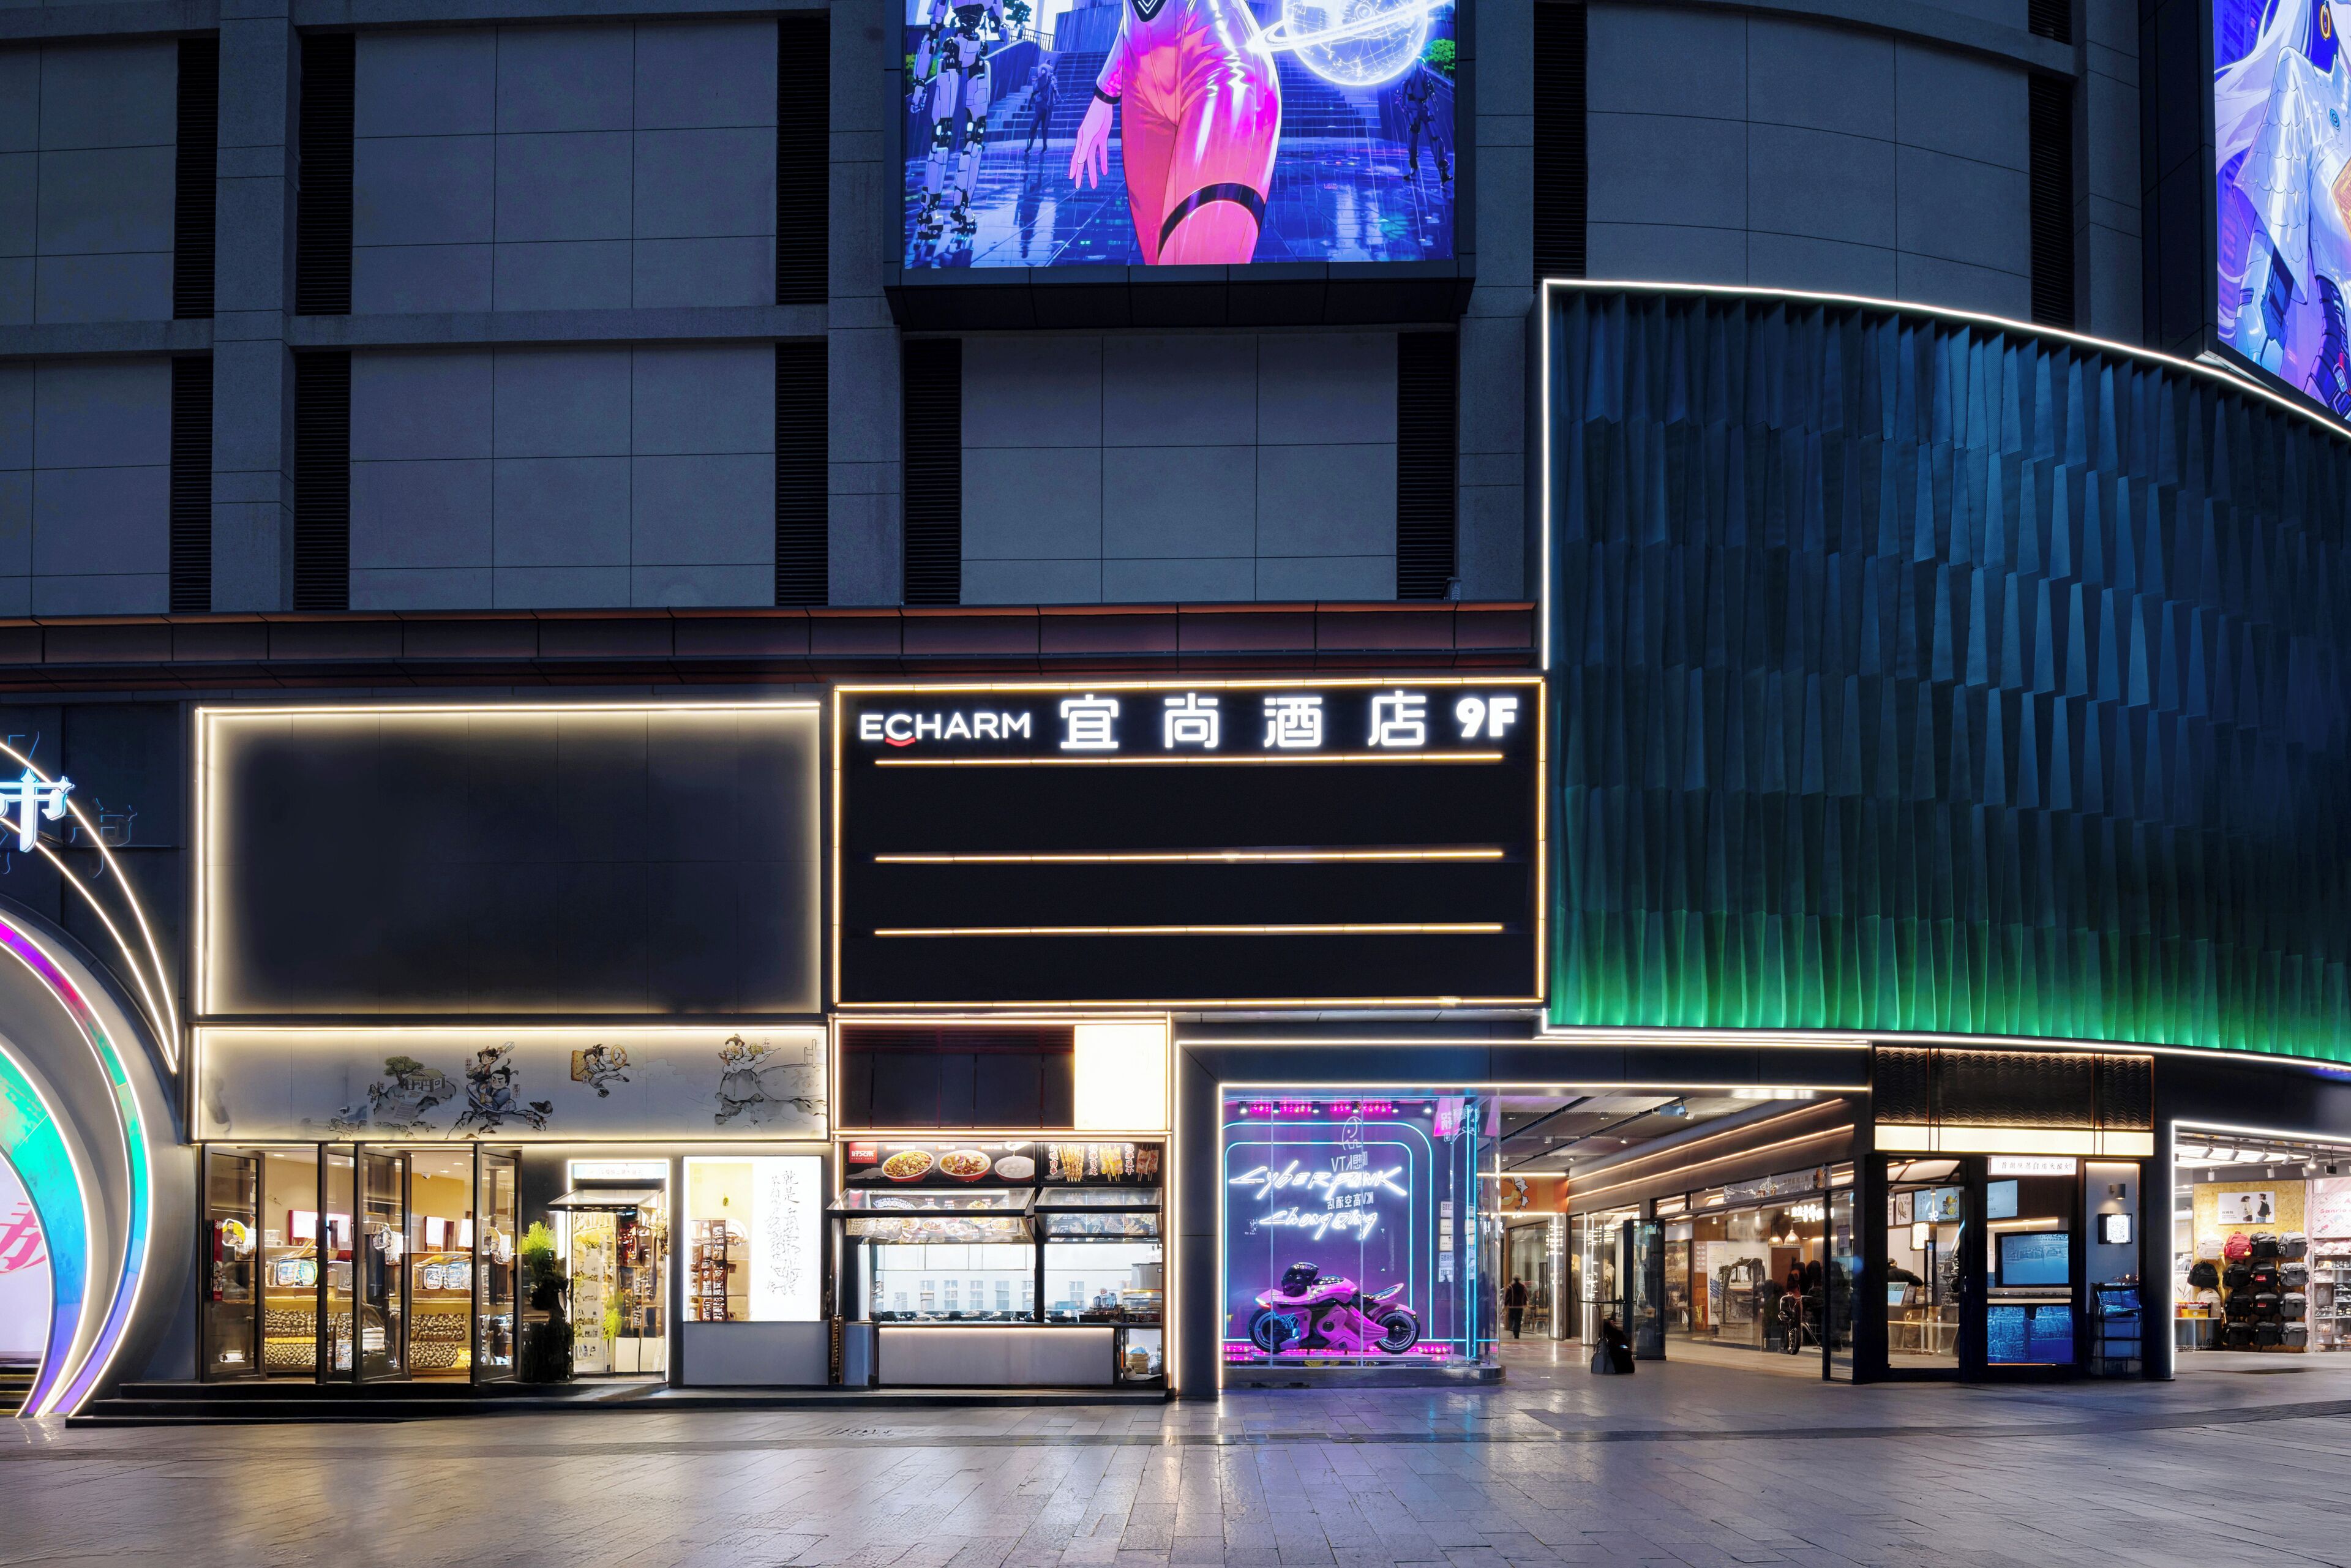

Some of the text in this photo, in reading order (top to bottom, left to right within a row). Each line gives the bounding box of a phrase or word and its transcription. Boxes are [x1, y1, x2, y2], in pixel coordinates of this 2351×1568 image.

[860, 692, 1517, 749] ECHARM 宜尚酒店 9F
